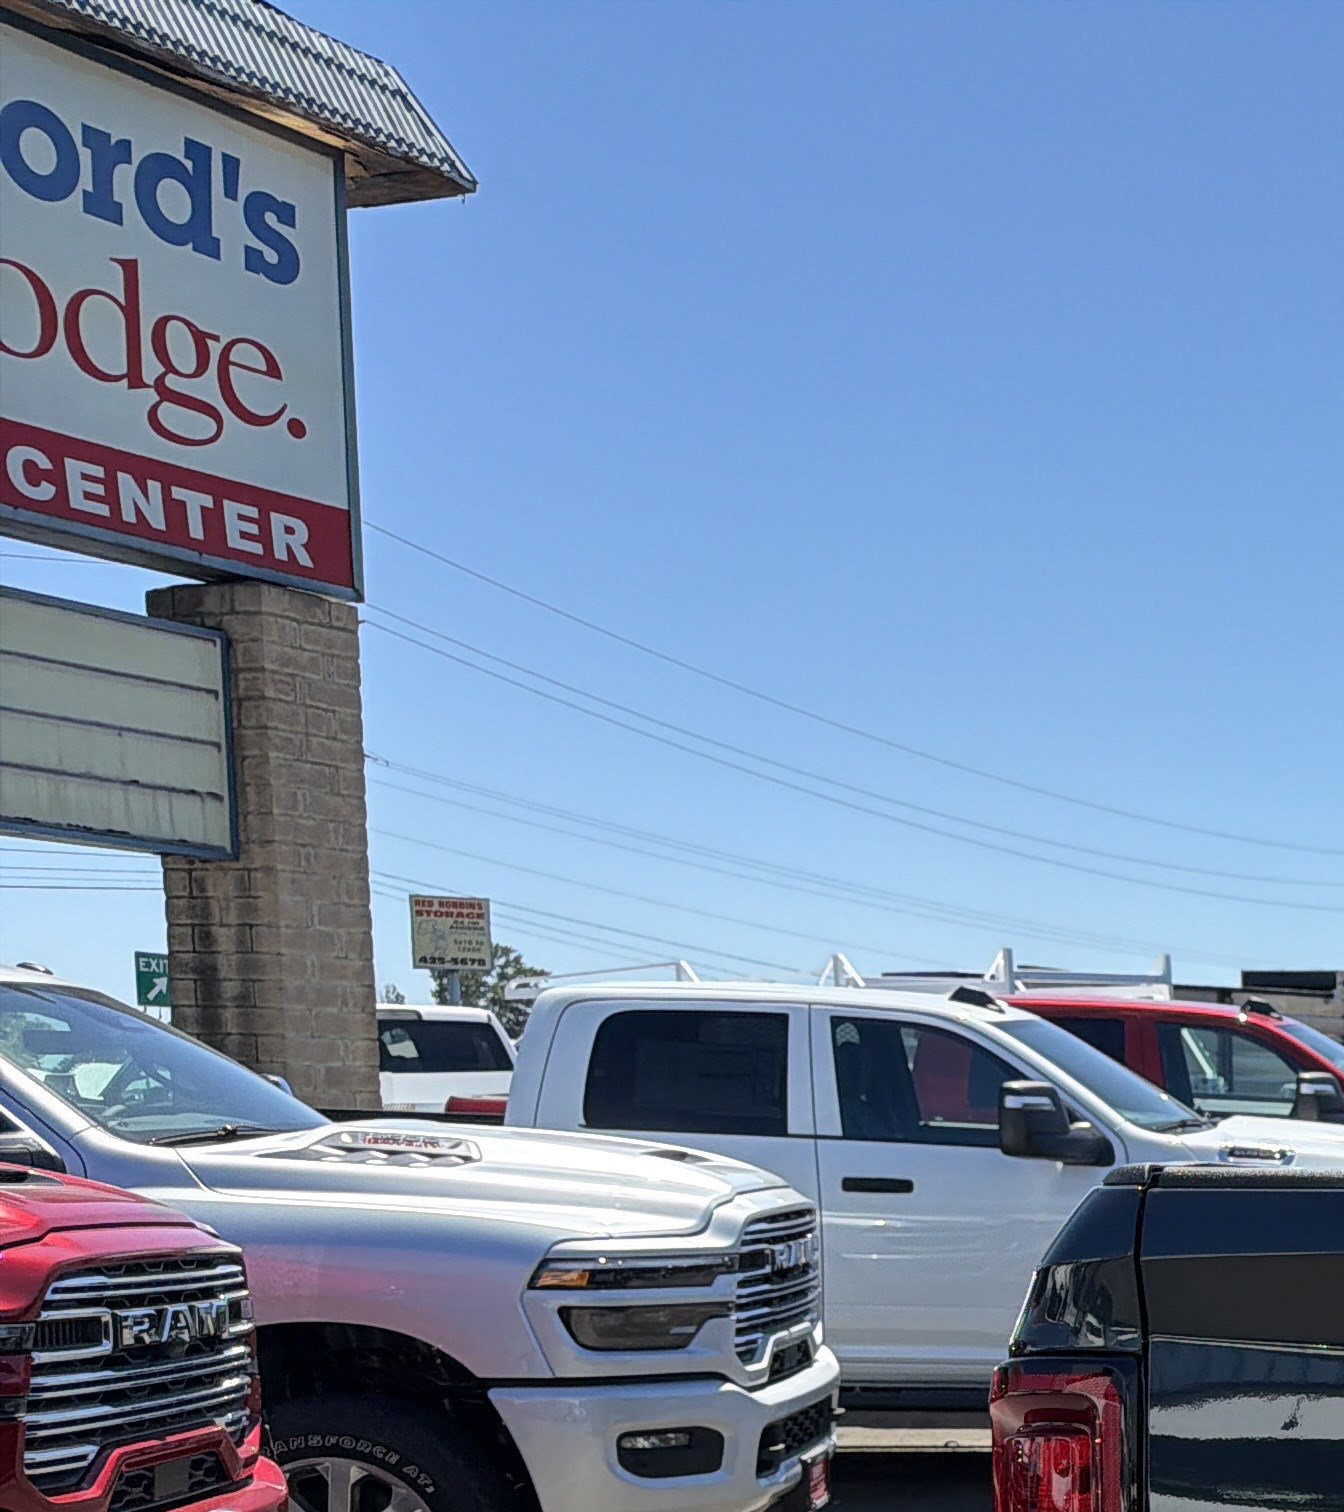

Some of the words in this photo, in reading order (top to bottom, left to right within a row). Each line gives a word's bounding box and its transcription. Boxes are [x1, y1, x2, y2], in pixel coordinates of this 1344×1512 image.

[5, 445, 314, 568] CENTER
[415, 909, 485, 920] STORAGE
[119, 1299, 230, 1349] RAM
